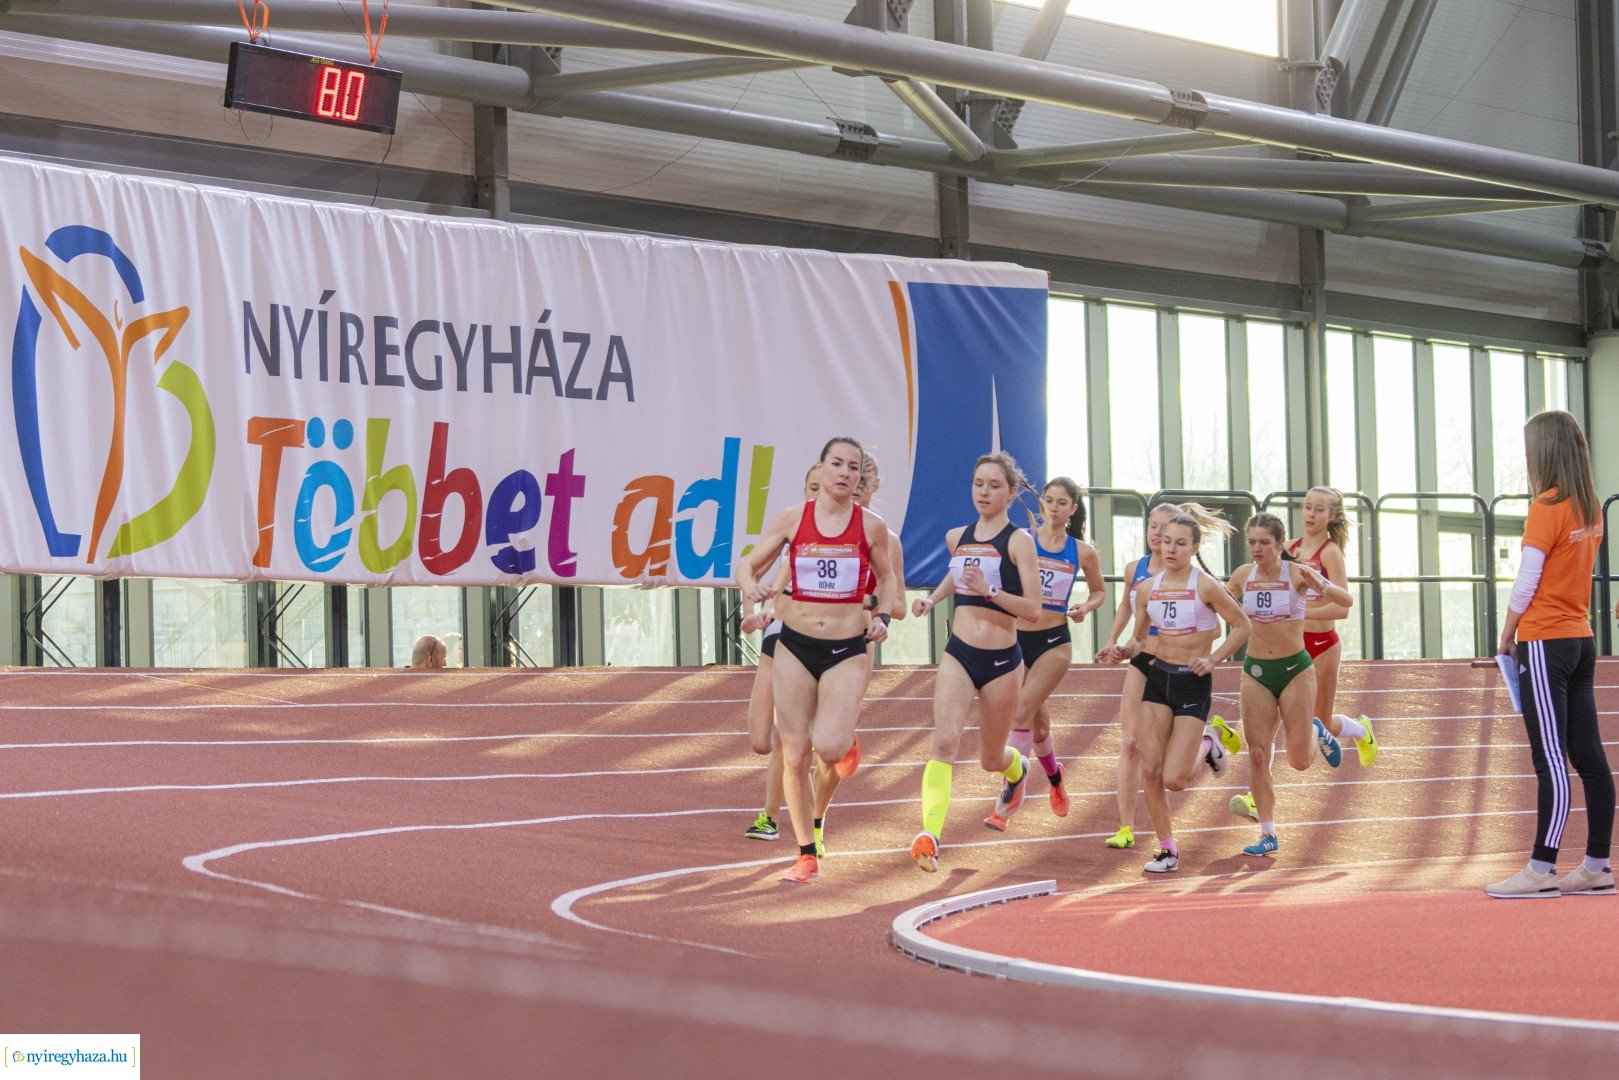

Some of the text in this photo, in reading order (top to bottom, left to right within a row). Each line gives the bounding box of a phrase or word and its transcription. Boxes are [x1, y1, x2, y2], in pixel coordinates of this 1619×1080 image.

[317, 66, 365, 121] 8.0
[243, 289, 635, 402] NYÍREGYHÁZA
[247, 416, 775, 579] Többet ad!
[816, 559, 837, 579] 38
[1161, 601, 1177, 619] 75
[1257, 592, 1272, 608] 69
